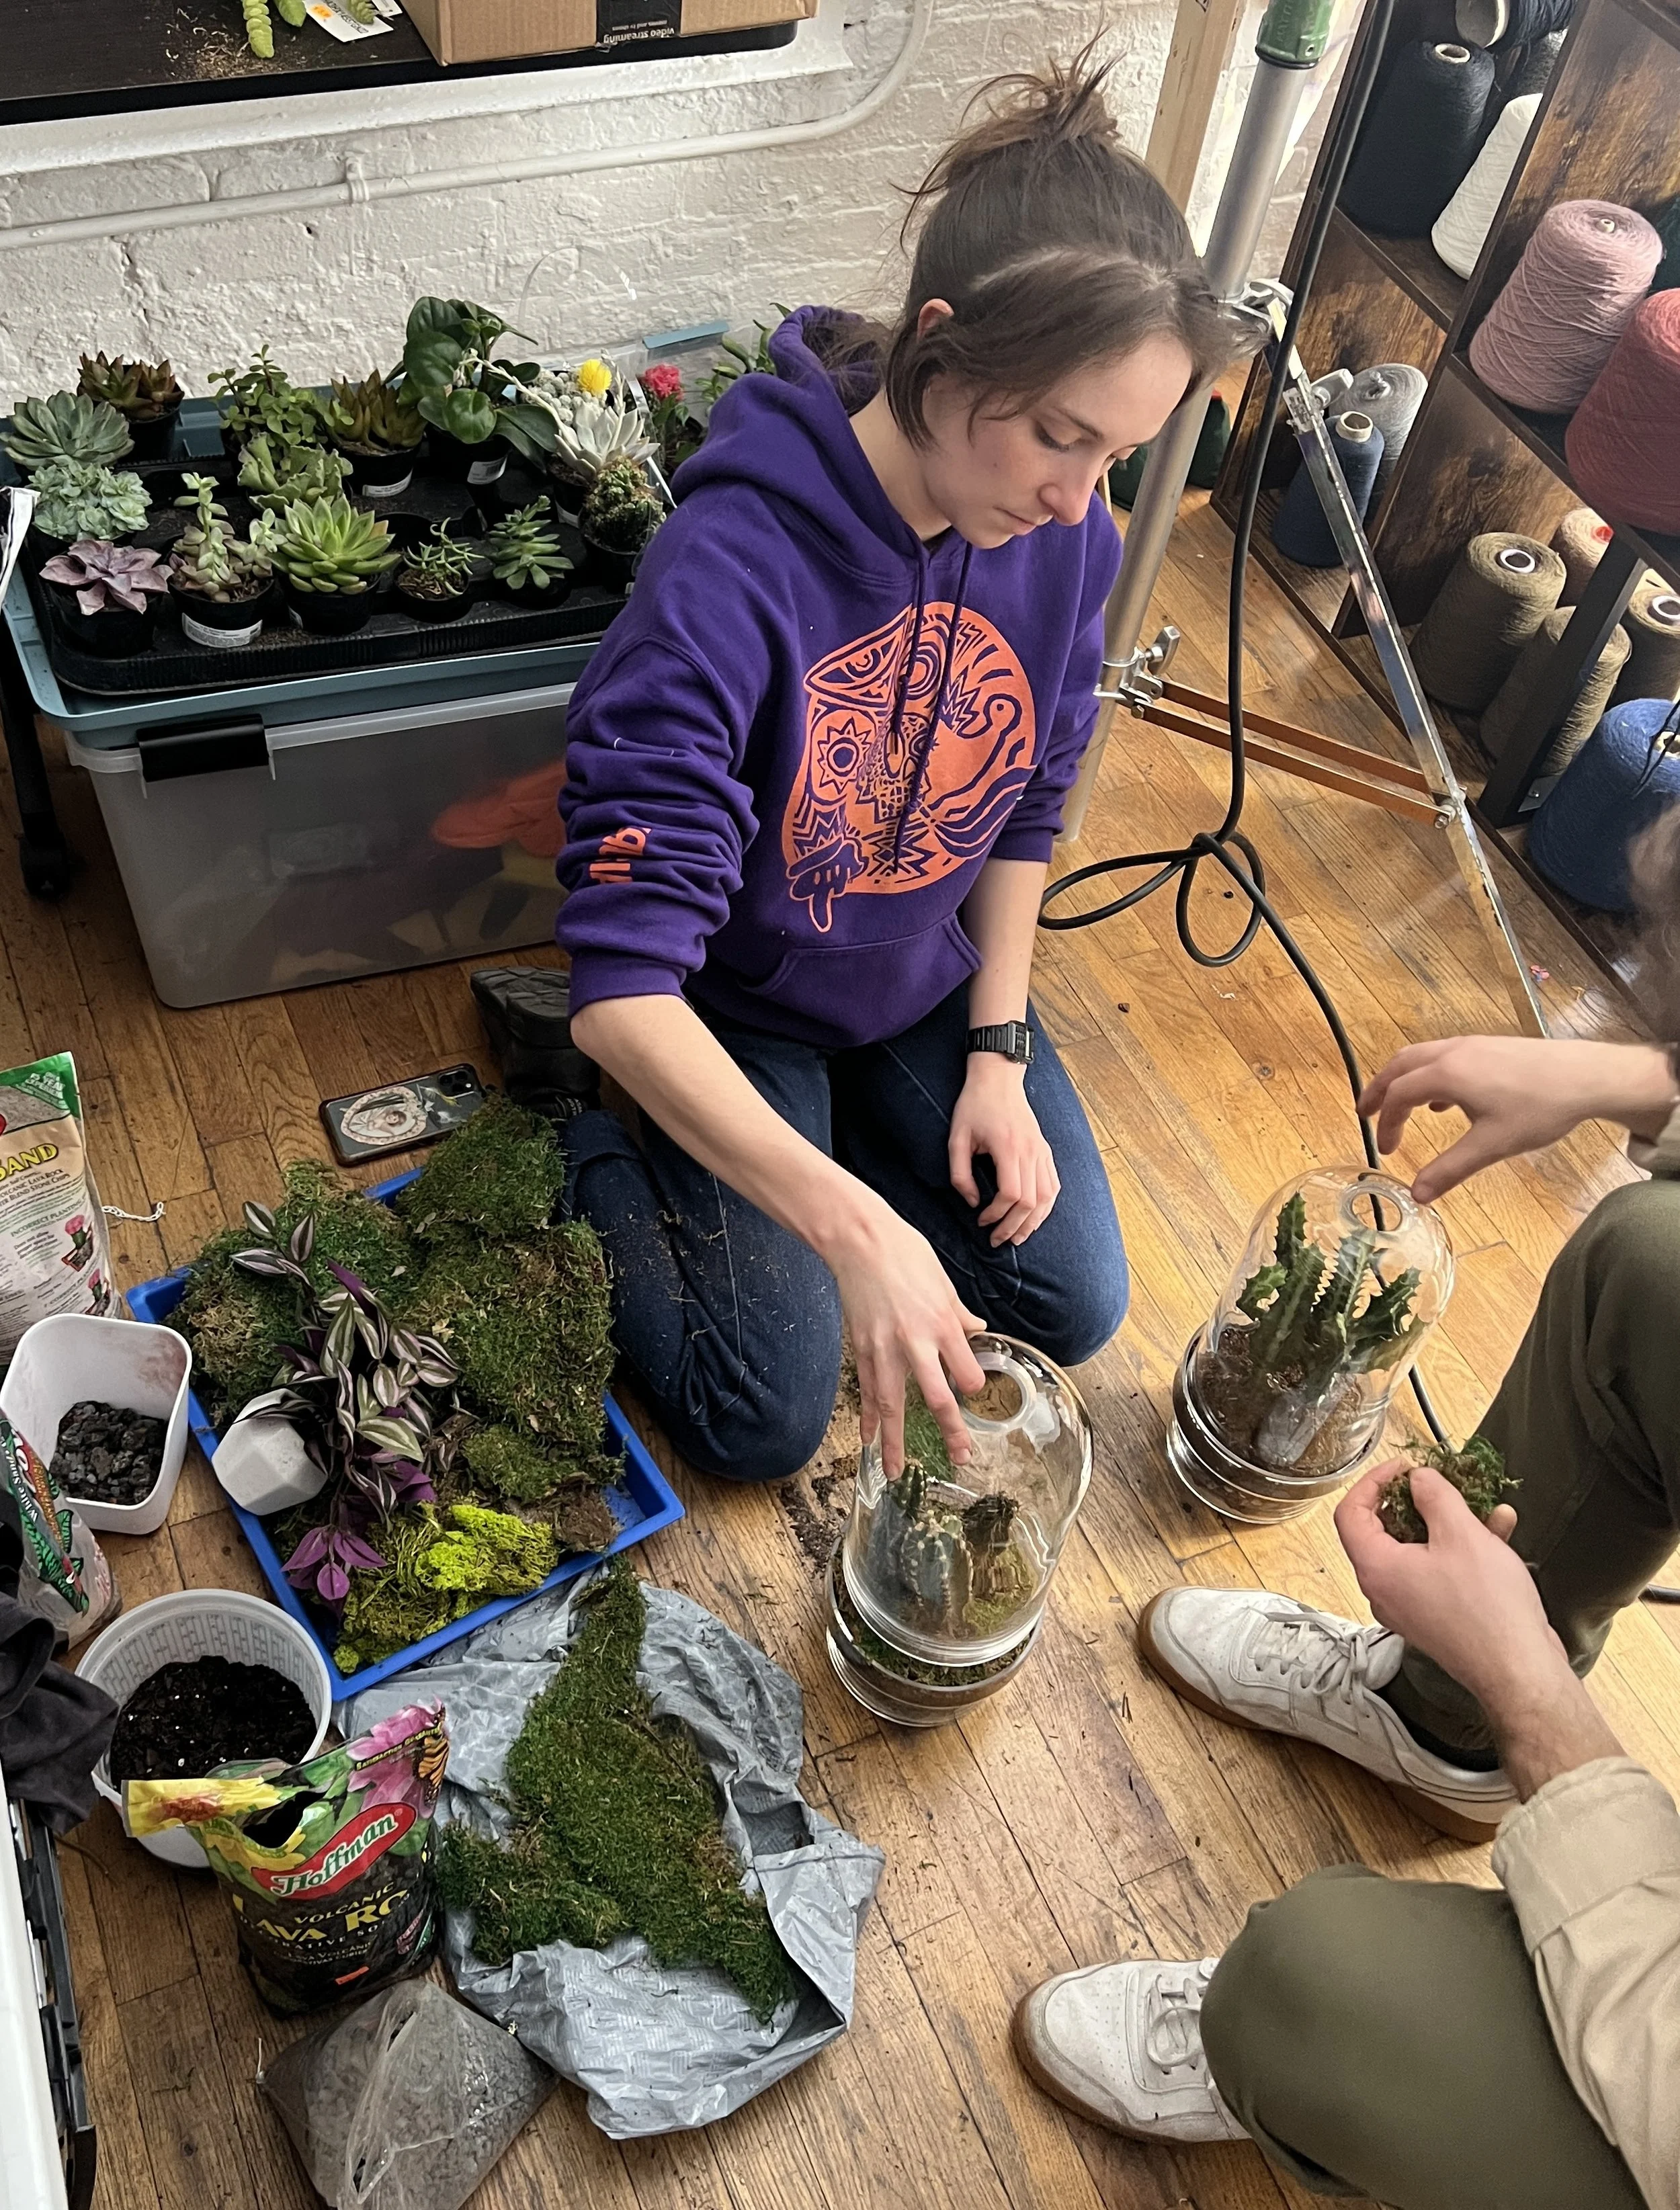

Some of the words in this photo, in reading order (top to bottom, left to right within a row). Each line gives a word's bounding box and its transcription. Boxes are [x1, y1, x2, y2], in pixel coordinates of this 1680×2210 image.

[603, 30, 649, 44] streaming
[650, 28, 675, 38] video
[28, 1175, 45, 1185] LAVA
[30, 1181, 50, 1191] STONE
[11, 1216, 49, 1237] INCORRECT
[6, 1455, 22, 1485] Sand
[17, 1486, 38, 1523] White
[270, 1814, 399, 1897] Hoffman
[294, 1881, 394, 1924] VOLCANIC
[345, 1888, 409, 1932] RO
